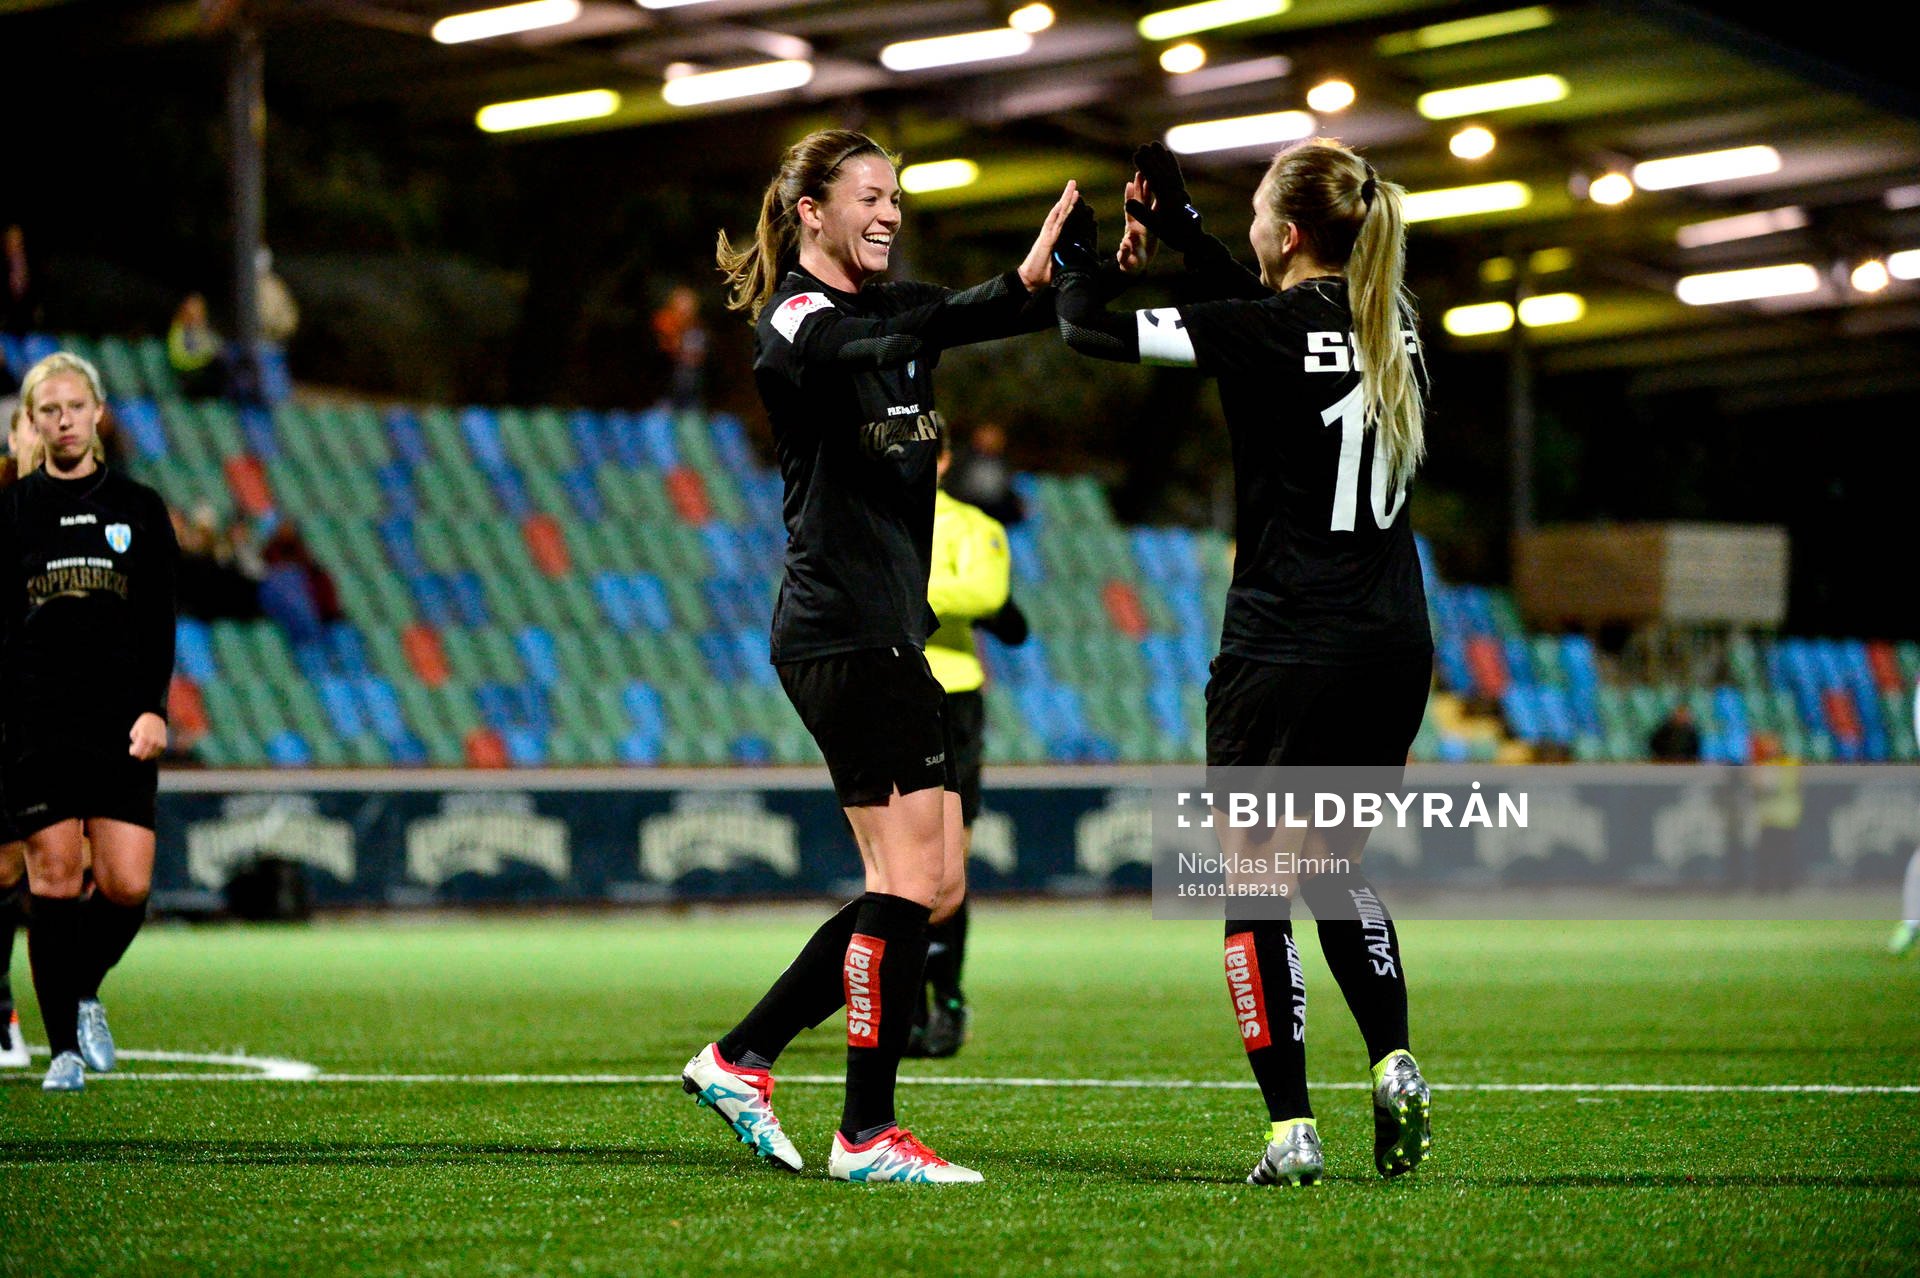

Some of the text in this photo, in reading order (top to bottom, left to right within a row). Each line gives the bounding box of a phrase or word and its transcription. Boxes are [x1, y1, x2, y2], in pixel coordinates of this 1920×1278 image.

[1320, 380, 1406, 532] 10
[845, 943, 873, 1037] stavdal
[1226, 944, 1260, 1039] stavdal
